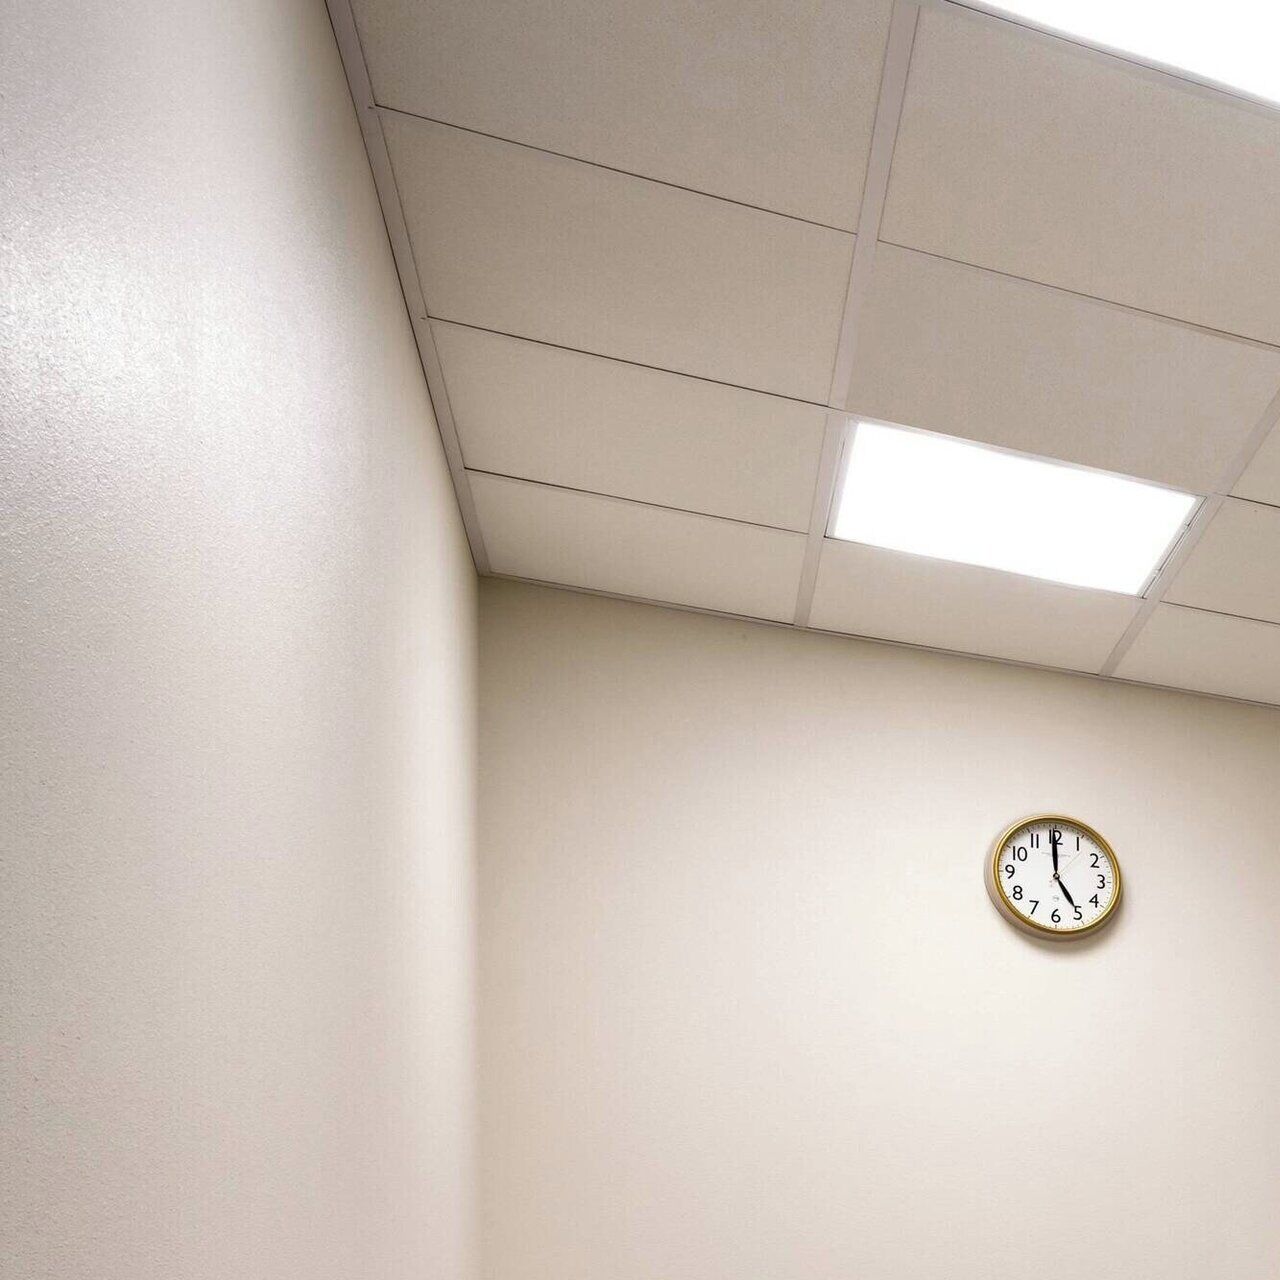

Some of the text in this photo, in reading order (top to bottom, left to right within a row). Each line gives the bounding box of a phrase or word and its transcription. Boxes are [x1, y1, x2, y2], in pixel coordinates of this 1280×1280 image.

[1030, 833, 1039, 848] 11
[1076, 837, 1080, 851] 1
[1012, 845, 1028, 861] 10
[1089, 853, 1099, 868] 2
[1005, 864, 1015, 879] 9
[1096, 874, 1105, 889] 3
[1012, 885, 1023, 900] 8
[1029, 900, 1039, 915] 7
[1089, 893, 1099, 908] 4
[1051, 909, 1061, 923] 6
[1073, 905, 1083, 920] 5
